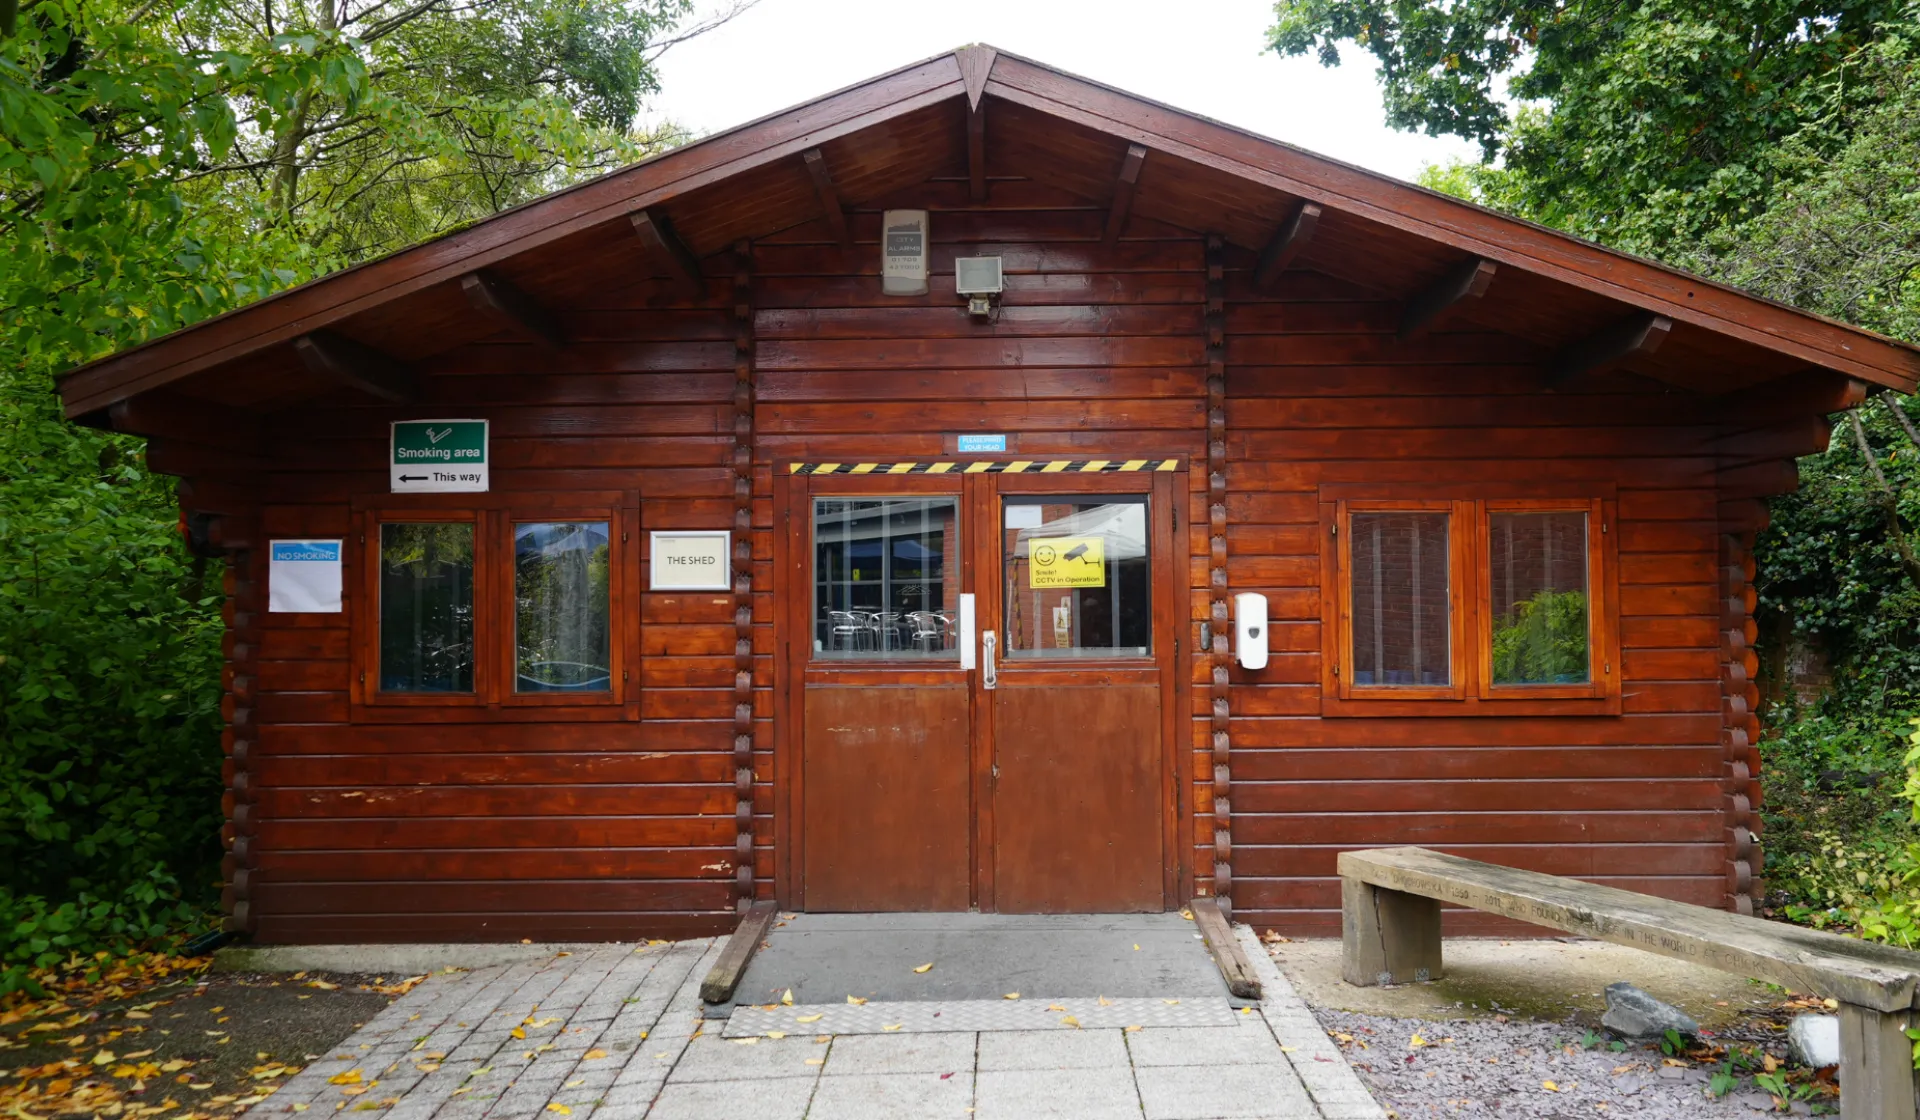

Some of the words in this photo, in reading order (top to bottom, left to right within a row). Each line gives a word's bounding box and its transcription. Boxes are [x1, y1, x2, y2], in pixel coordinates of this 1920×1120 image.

[398, 447, 451, 460] Smoking
[454, 448, 480, 457] area
[433, 472, 457, 482] This
[459, 473, 481, 483] way
[278, 552, 292, 560] NO
[293, 551, 337, 560] SMOKING
[667, 556, 686, 565] THE
[688, 556, 716, 565] SHED
[1065, 576, 1100, 584] Operation
[1531, 905, 1560, 923] FOUND
[1624, 927, 1635, 940] IN
[1638, 930, 1657, 946] THE
[1661, 936, 1696, 956] WORLD
